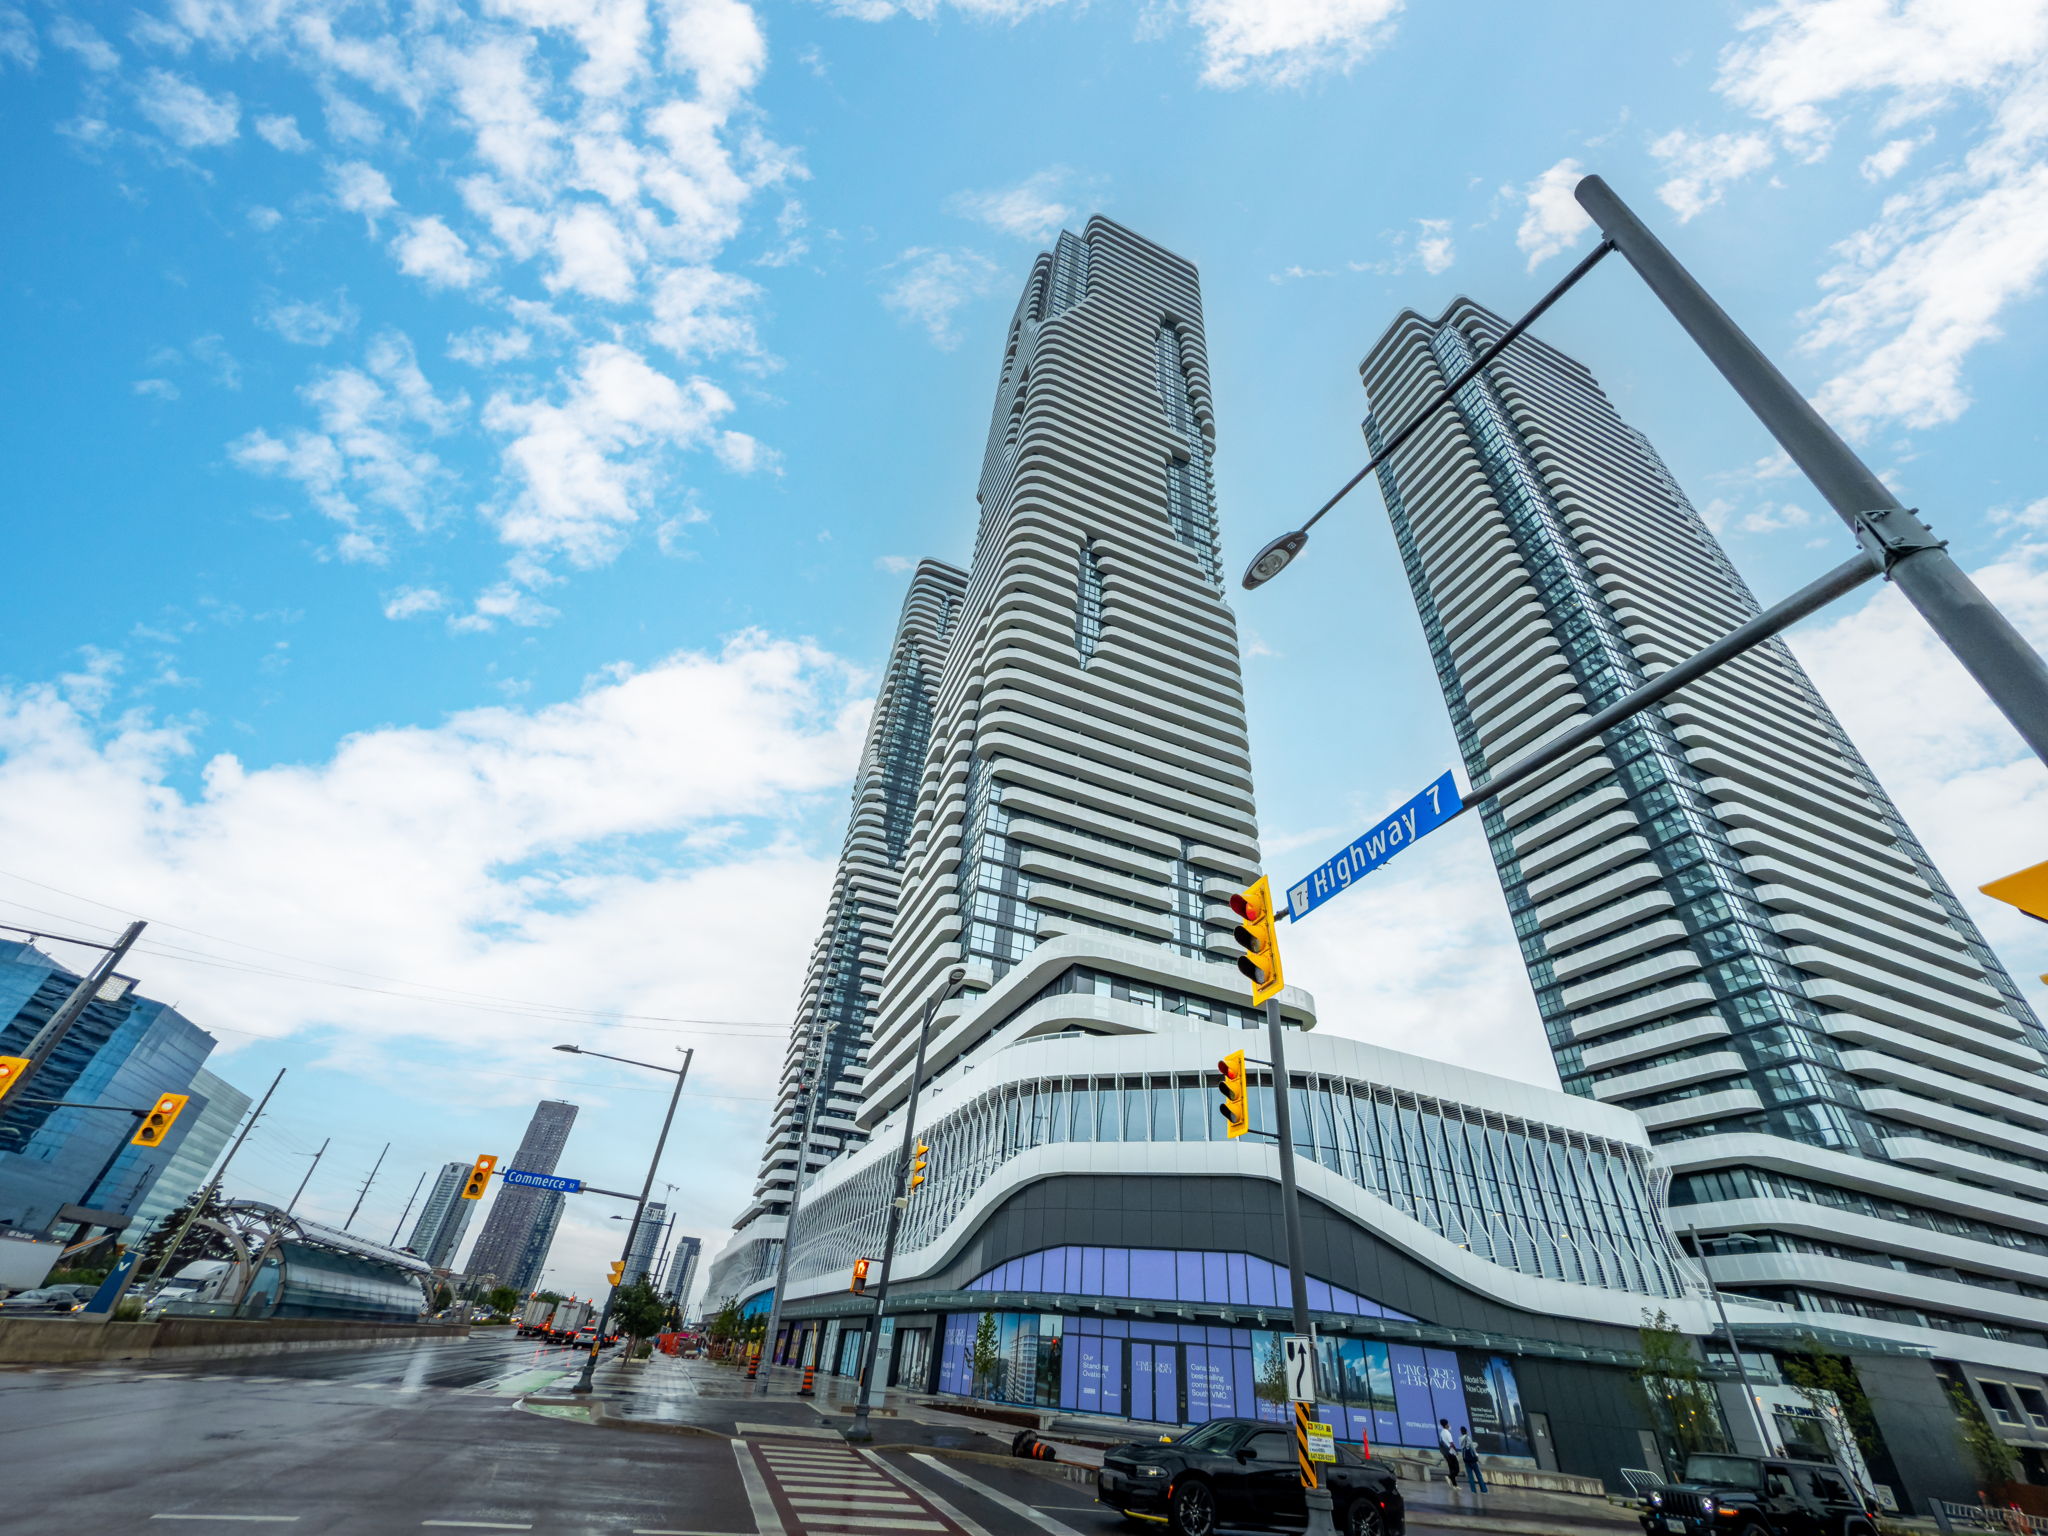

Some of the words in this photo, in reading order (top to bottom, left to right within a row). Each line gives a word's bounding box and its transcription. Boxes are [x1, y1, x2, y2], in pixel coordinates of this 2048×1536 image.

[1313, 807, 1416, 897] Highway
[1425, 784, 1441, 816] 7
[508, 1171, 566, 1189] Commerce
[1083, 1353, 1094, 1361] Our
[1397, 1363, 1455, 1380] ENCORE
[1407, 1375, 1457, 1391] BRAVO
